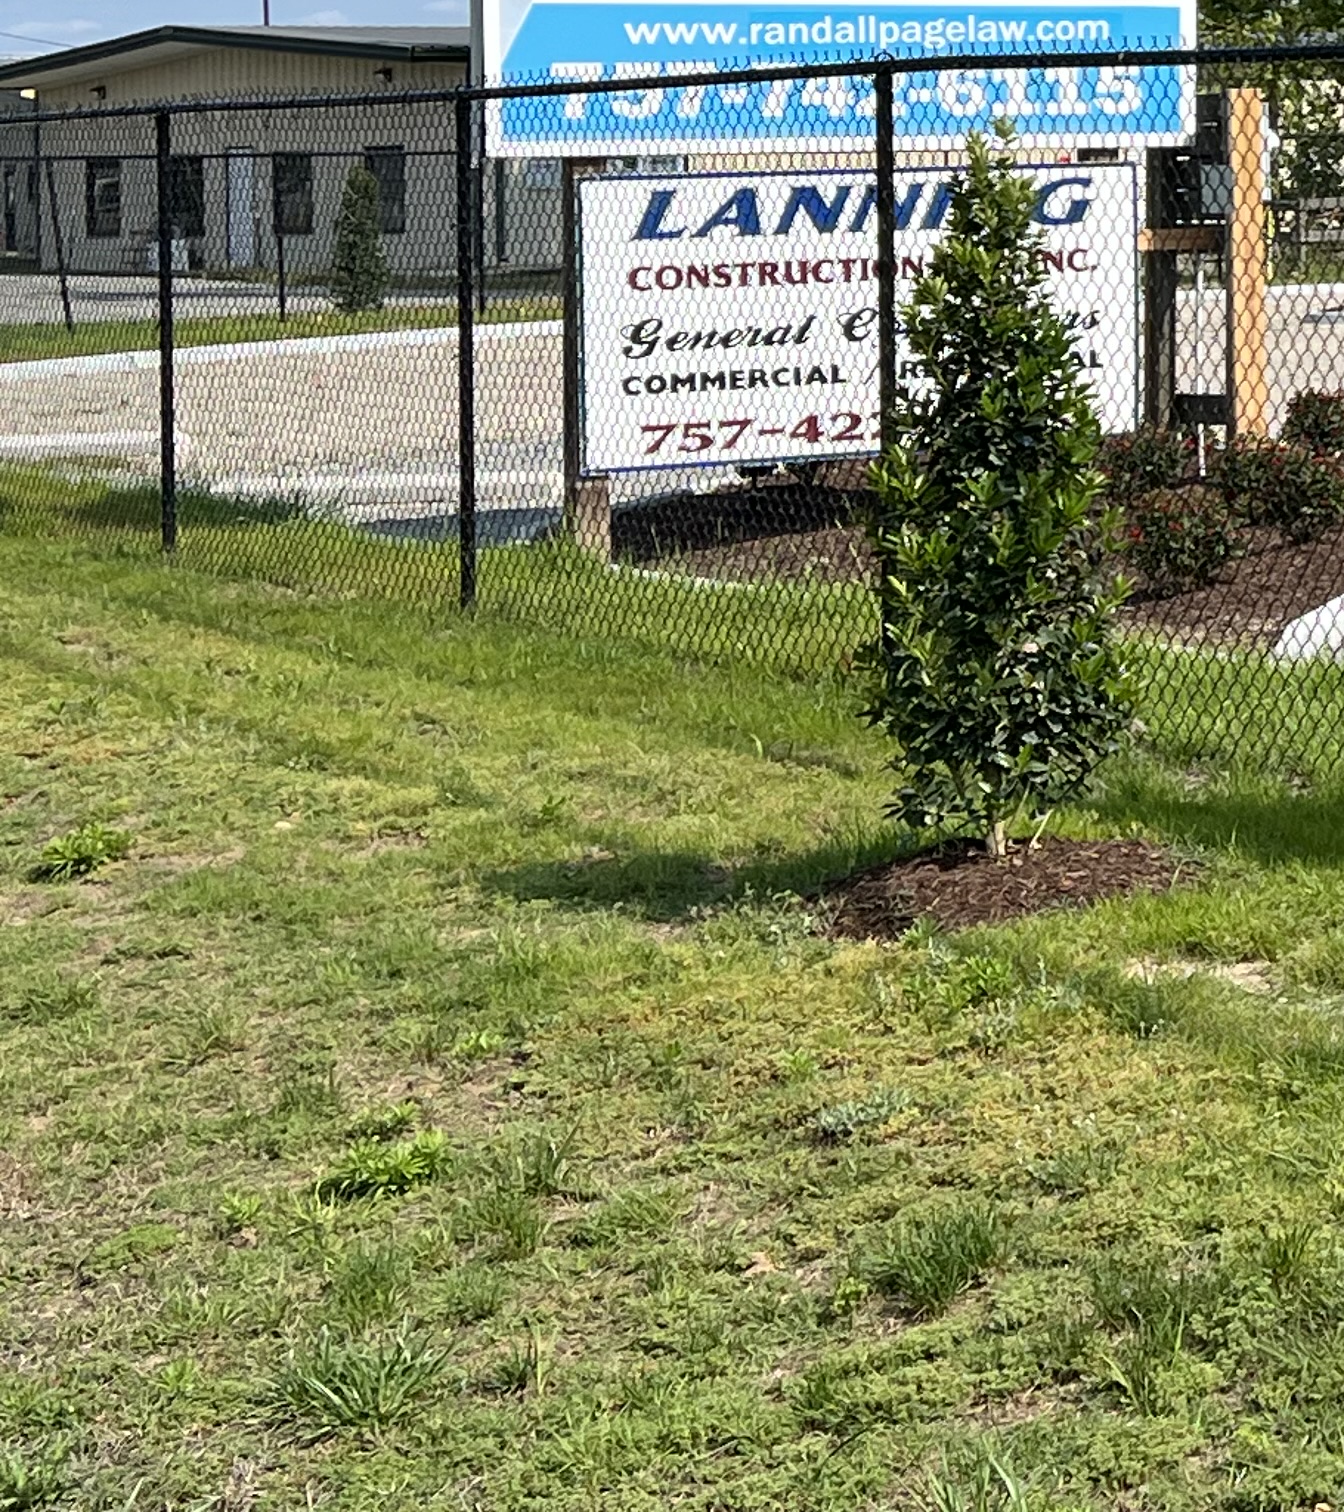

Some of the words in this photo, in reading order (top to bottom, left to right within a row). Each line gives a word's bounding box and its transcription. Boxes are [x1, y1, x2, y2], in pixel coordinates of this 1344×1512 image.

[623, 14, 1110, 49] www.randallpagelaw.com
[630, 176, 1092, 241] LANNIG
[620, 313, 817, 360] General
[621, 364, 847, 396] COMMERCIAL
